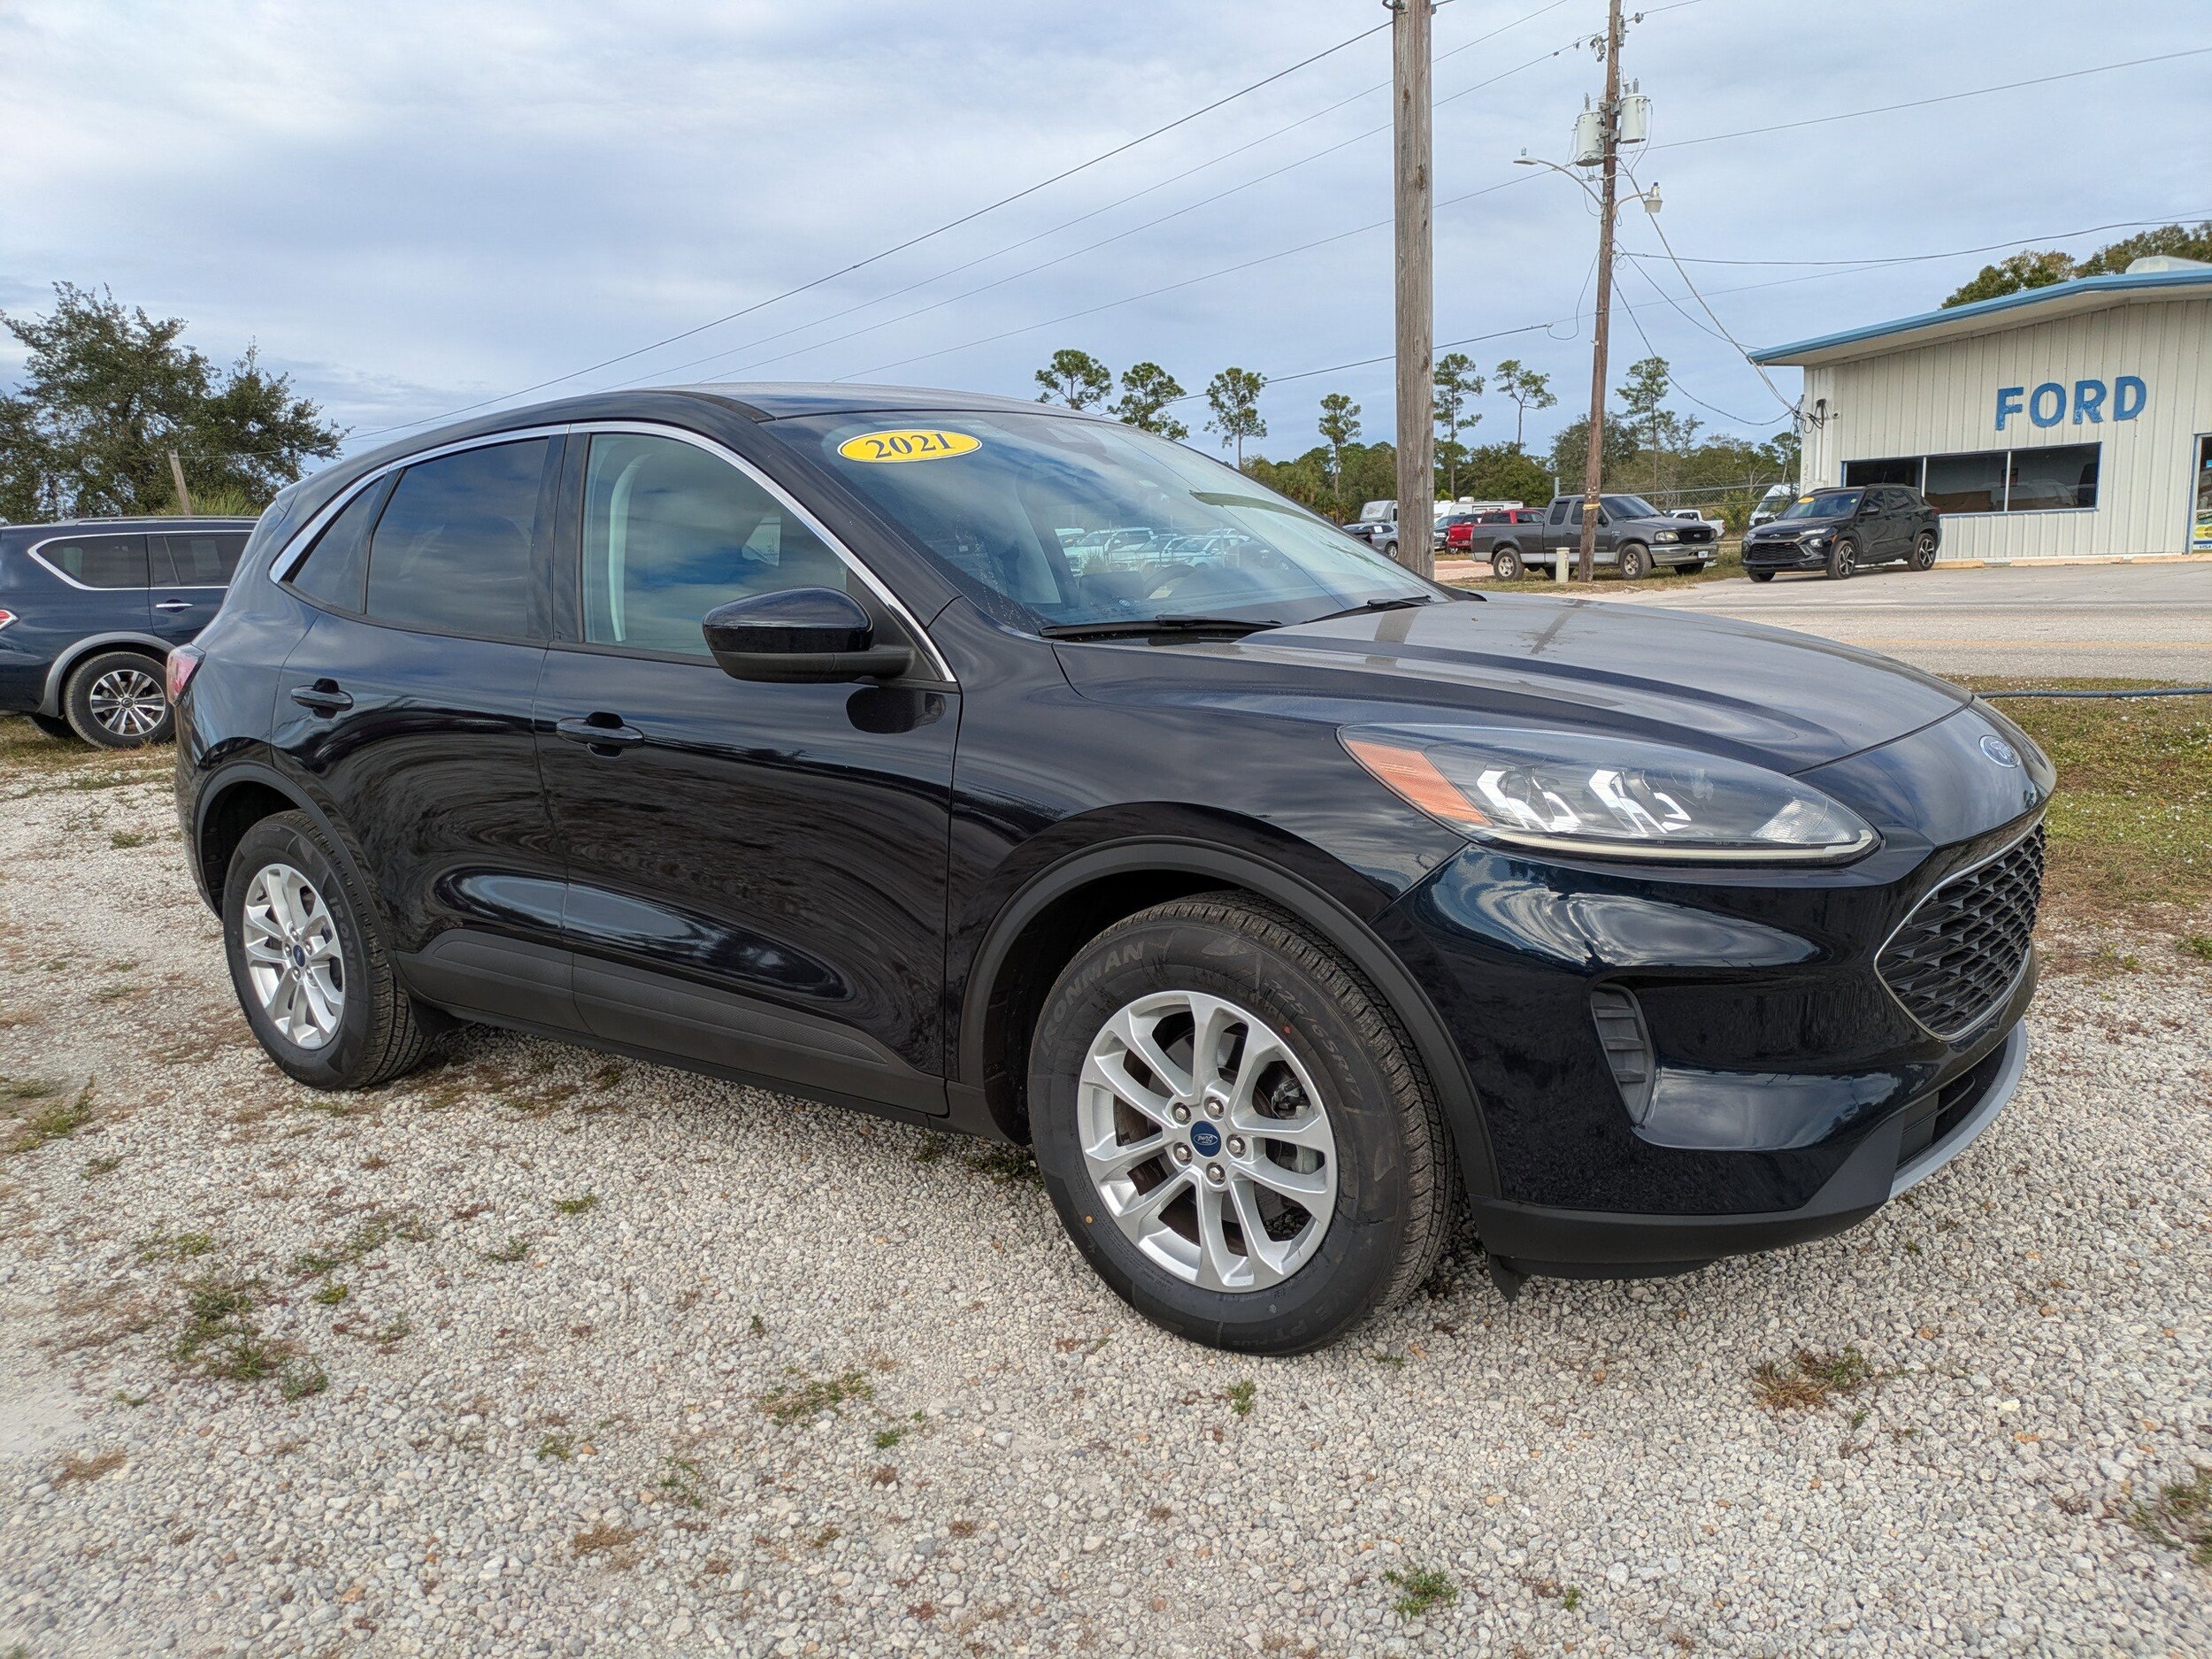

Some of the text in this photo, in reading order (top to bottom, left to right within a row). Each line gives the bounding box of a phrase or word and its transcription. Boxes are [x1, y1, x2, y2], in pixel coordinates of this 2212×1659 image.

[1995, 375, 2147, 431] FORD
[865, 433, 956, 459] 2021
[1041, 941, 1146, 1056] IRONMAN
